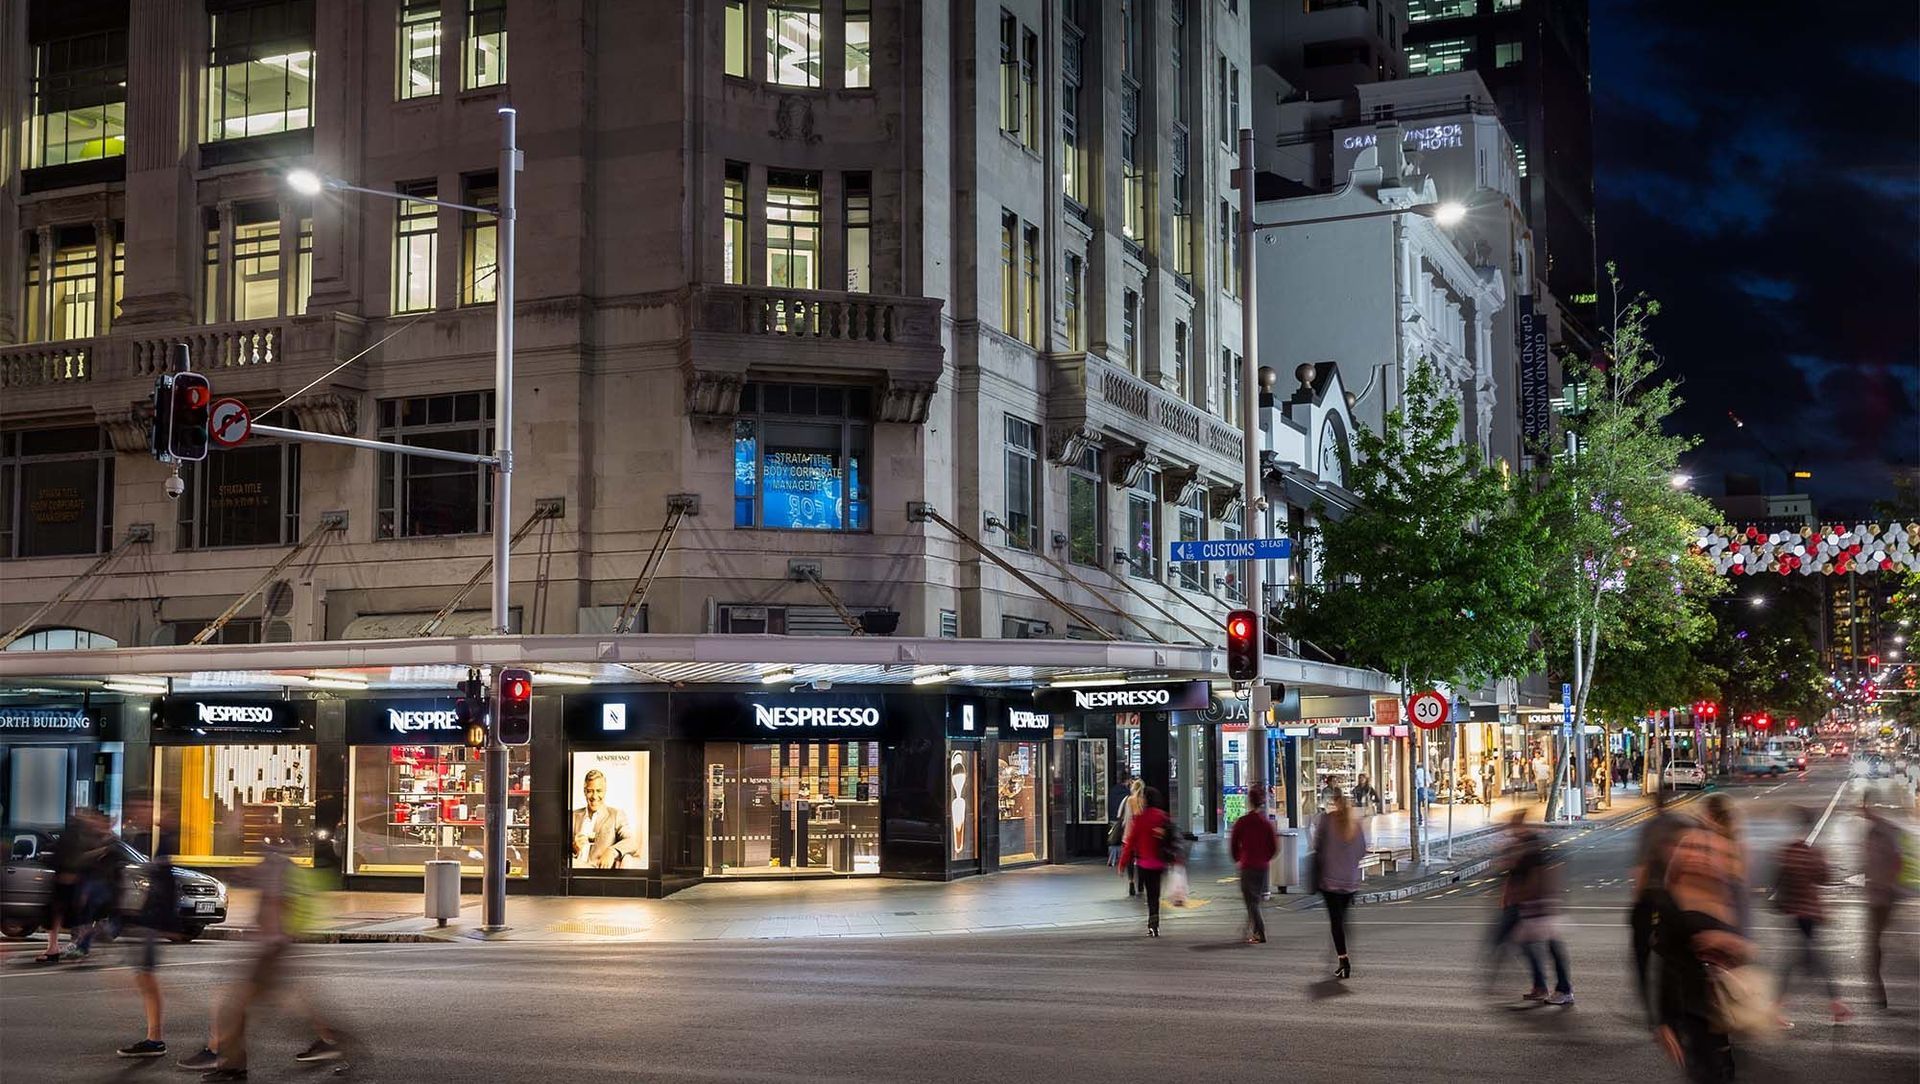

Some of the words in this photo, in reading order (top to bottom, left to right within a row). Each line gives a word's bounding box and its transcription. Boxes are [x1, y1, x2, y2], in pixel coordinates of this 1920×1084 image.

[1344, 135, 1377, 149] GRA
[1420, 136, 1463, 151] HOTEL
[1521, 313, 1534, 364] GRAND
[1535, 333, 1546, 381] GRAND
[775, 452, 807, 464] STRATA
[809, 453, 832, 465] TITLE
[763, 465, 788, 477] BODY
[790, 466, 842, 479] CORPORATE
[1203, 543, 1255, 557] CUSTOMS
[1269, 540, 1284, 548] EAST
[1072, 689, 1170, 710] NESPRESSO
[196, 702, 273, 724] NESPRESSO
[752, 703, 880, 730] NESPRESSO
[1418, 702, 1439, 717] 30
[33, 717, 90, 729] BUILDING
[1528, 714, 1552, 723] LOUIS
[596, 754, 630, 762] NESPRESSO
